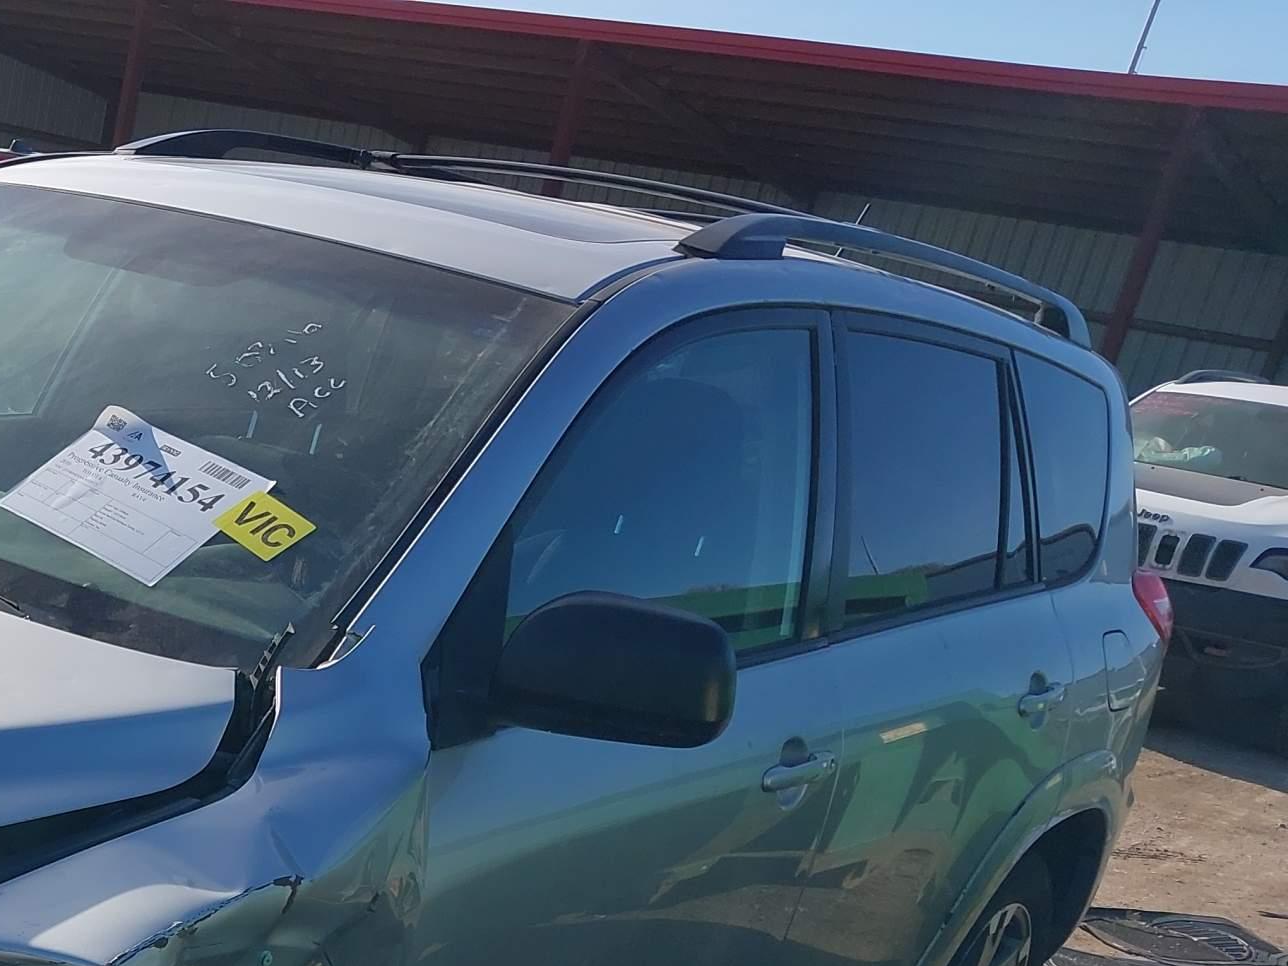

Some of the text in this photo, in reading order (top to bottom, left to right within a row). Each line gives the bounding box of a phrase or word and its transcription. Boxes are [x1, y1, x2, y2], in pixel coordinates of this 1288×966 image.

[87, 442, 225, 512] 43974154
[102, 467, 132, 487] Casualty
[132, 482, 166, 502] Insurance
[234, 501, 296, 548] VIC
[1137, 508, 1170, 523] Jeep
